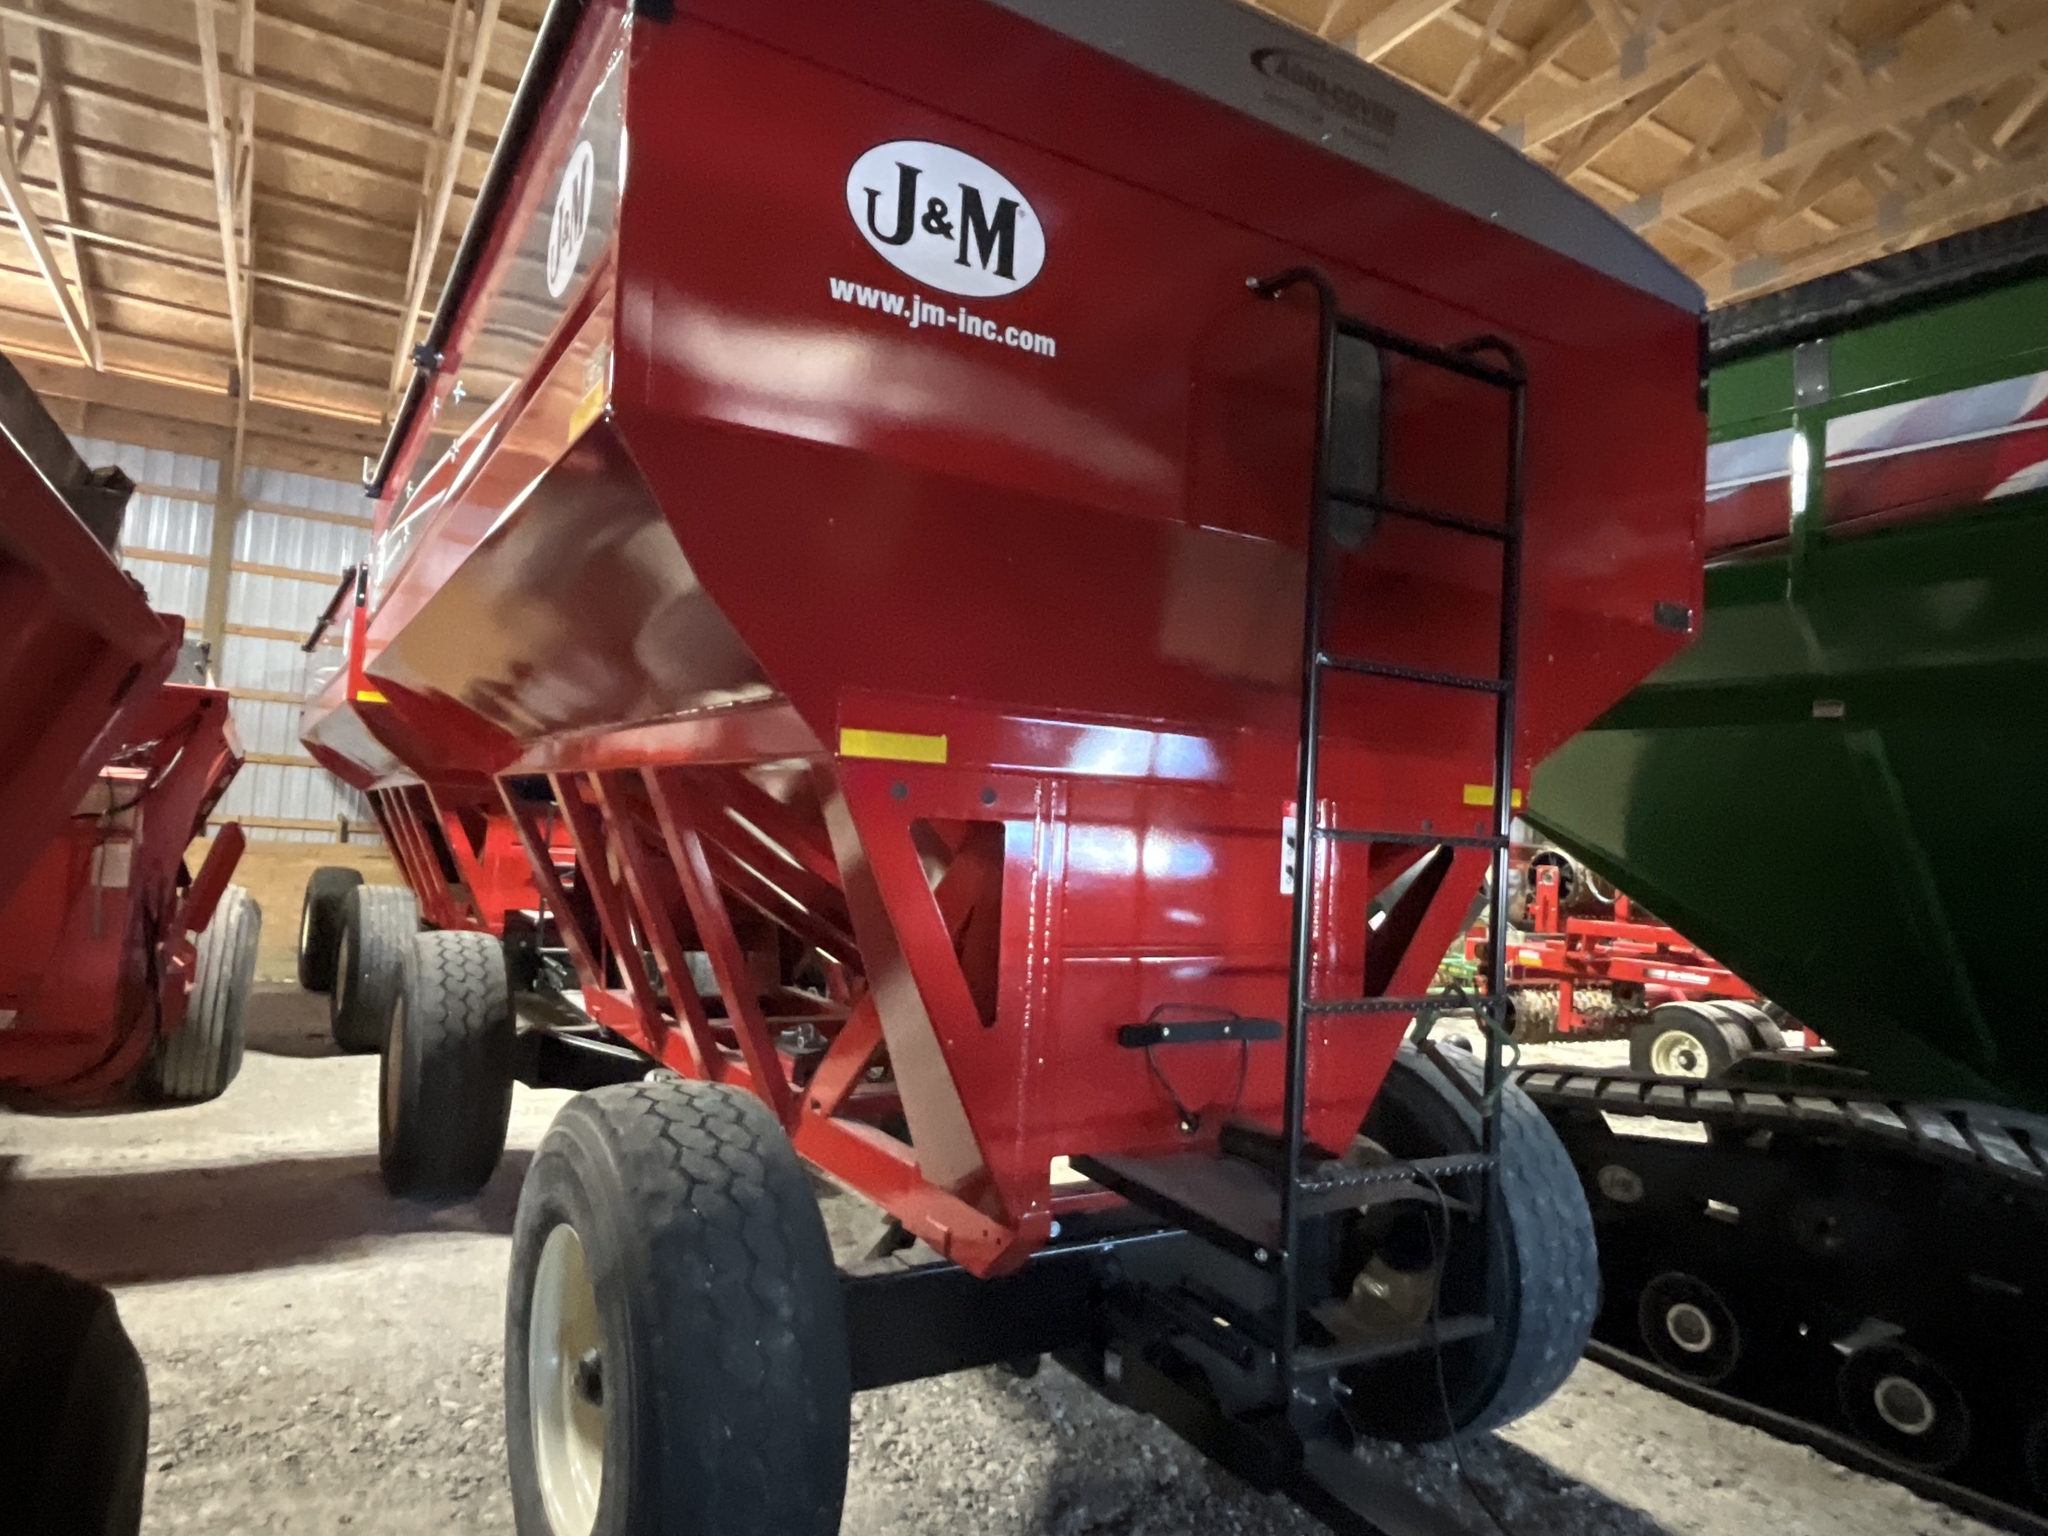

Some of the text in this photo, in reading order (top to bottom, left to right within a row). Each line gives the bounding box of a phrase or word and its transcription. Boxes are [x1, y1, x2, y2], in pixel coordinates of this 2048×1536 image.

[551, 153, 590, 285] J&M
[863, 161, 1020, 281] J&M
[829, 277, 1057, 357] www.jm-inc.com
